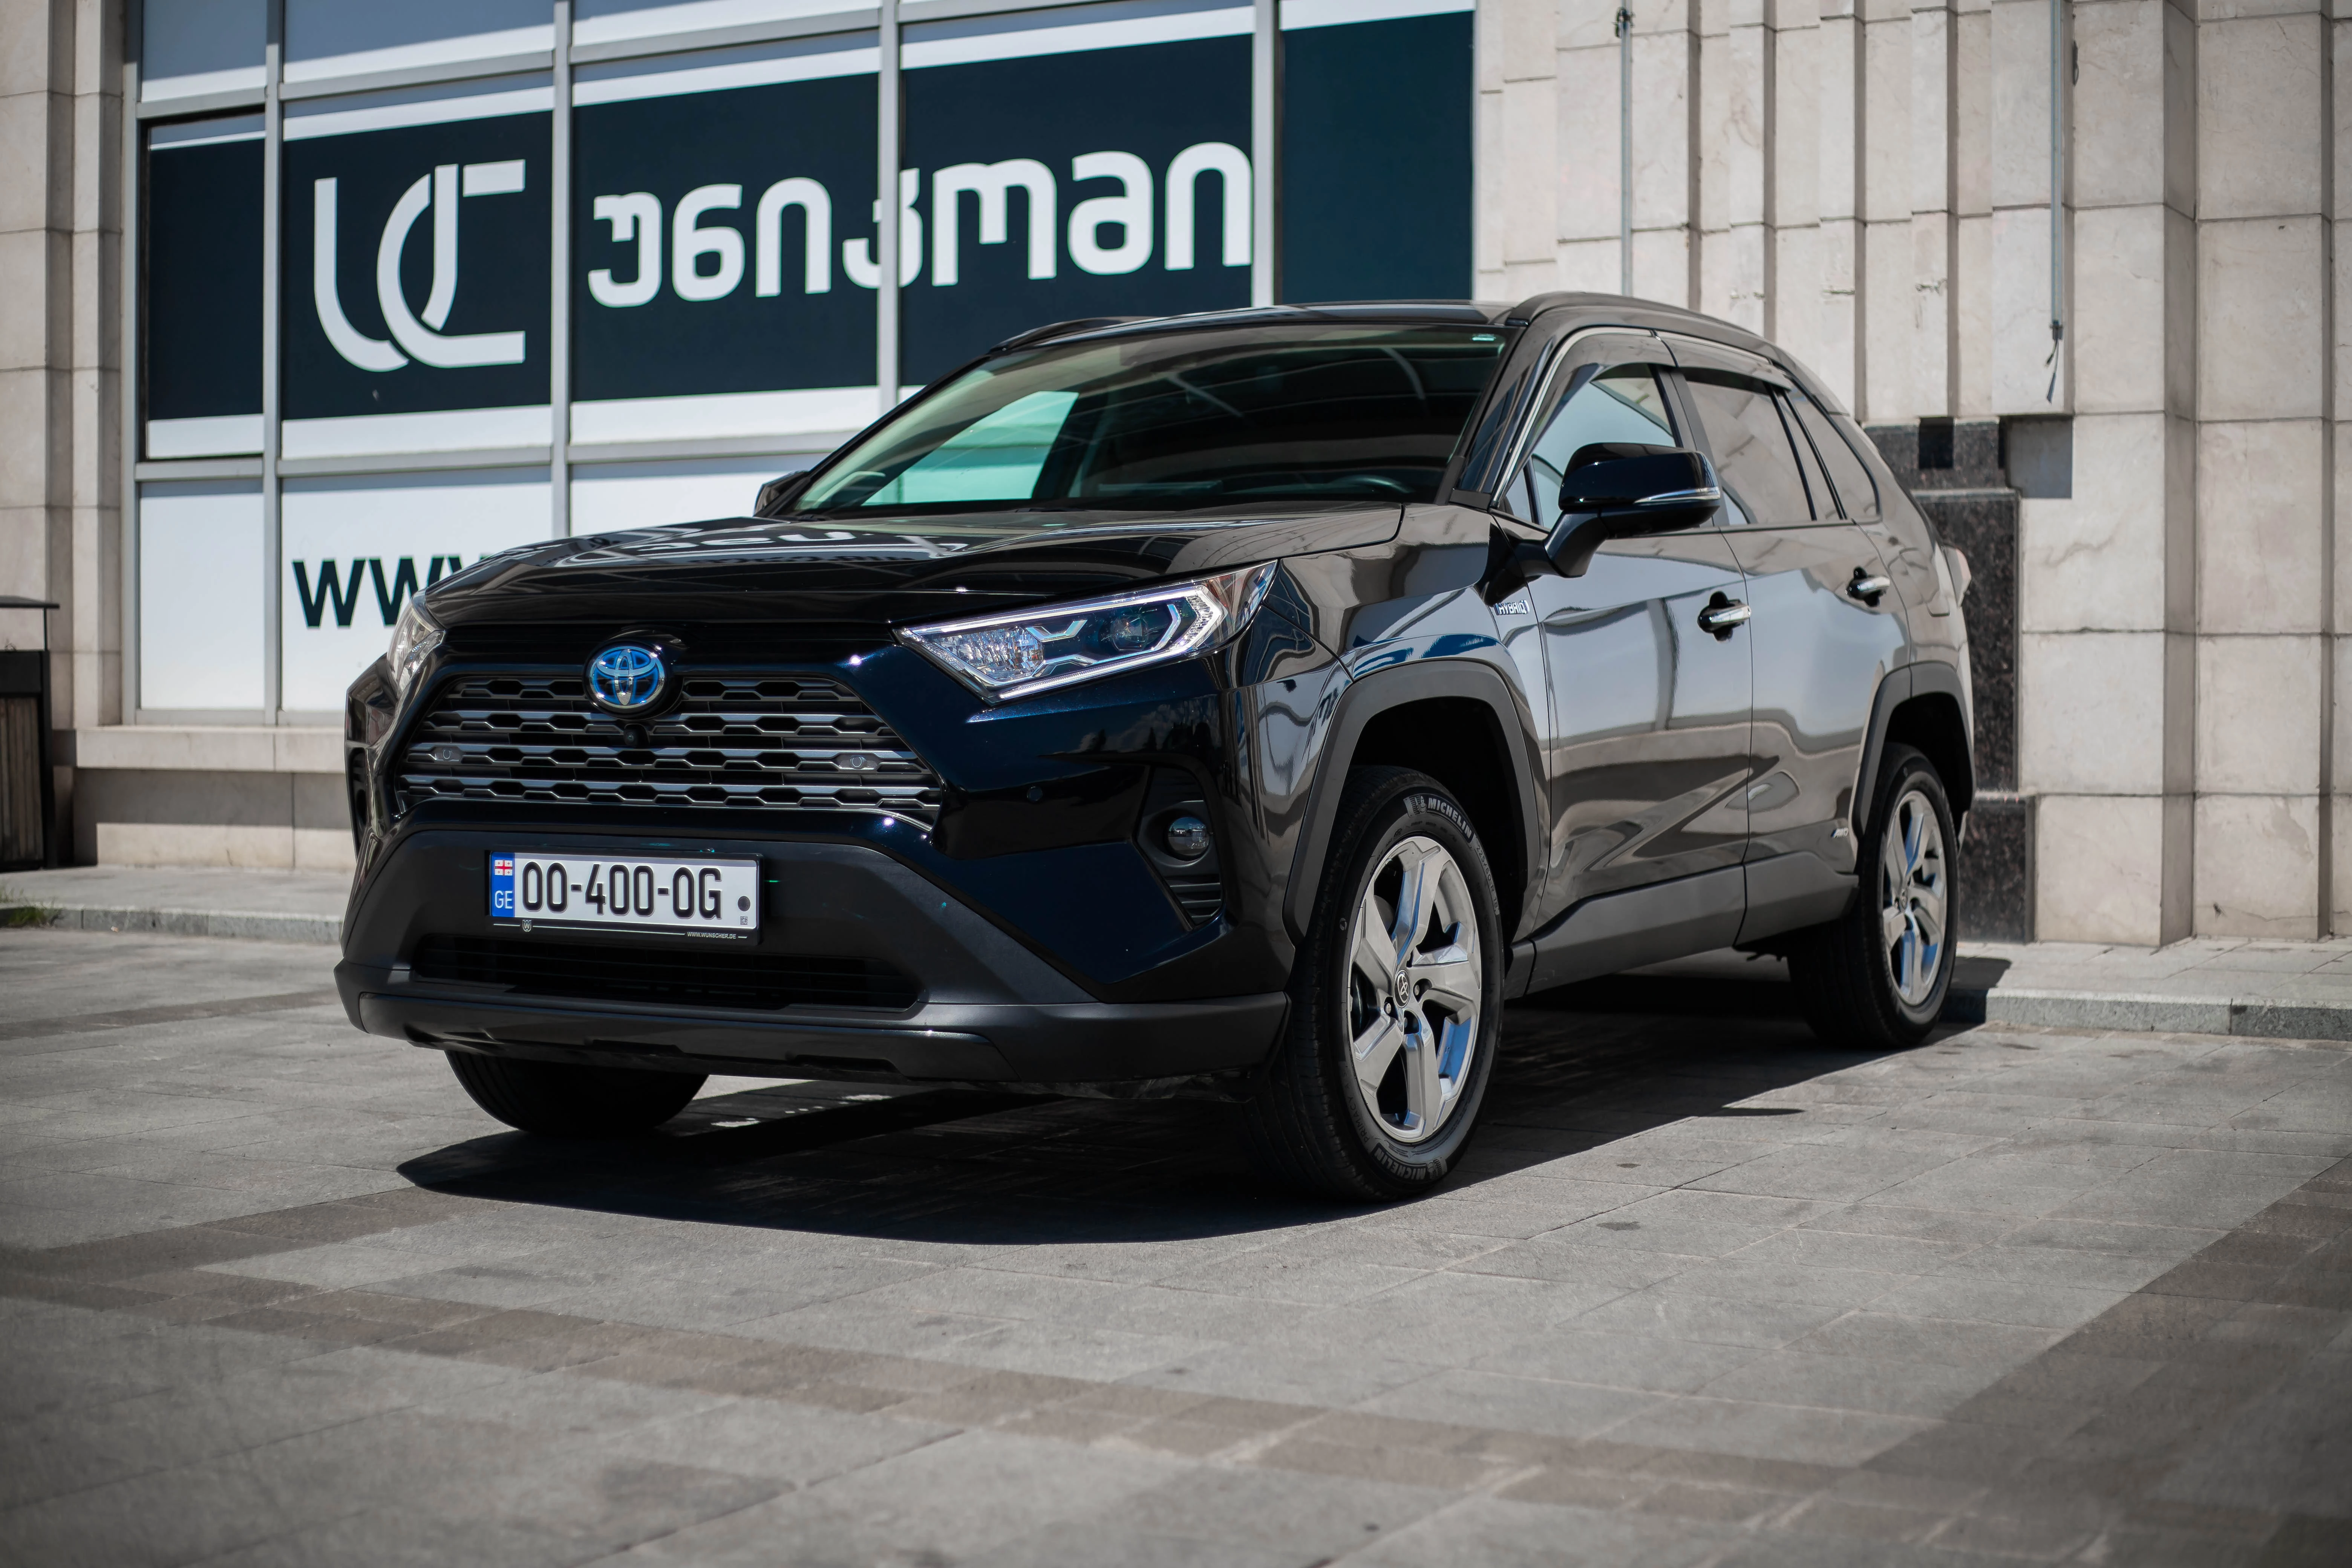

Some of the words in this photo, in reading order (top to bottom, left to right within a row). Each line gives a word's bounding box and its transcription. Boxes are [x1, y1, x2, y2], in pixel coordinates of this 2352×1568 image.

[1498, 601, 1527, 614] HYBRID
[1428, 797, 1472, 839] MICHELIN
[495, 890, 513, 909] GE
[1348, 1096, 1370, 1144] PRIMACY
[1375, 1147, 1426, 1179] MICHELIN
